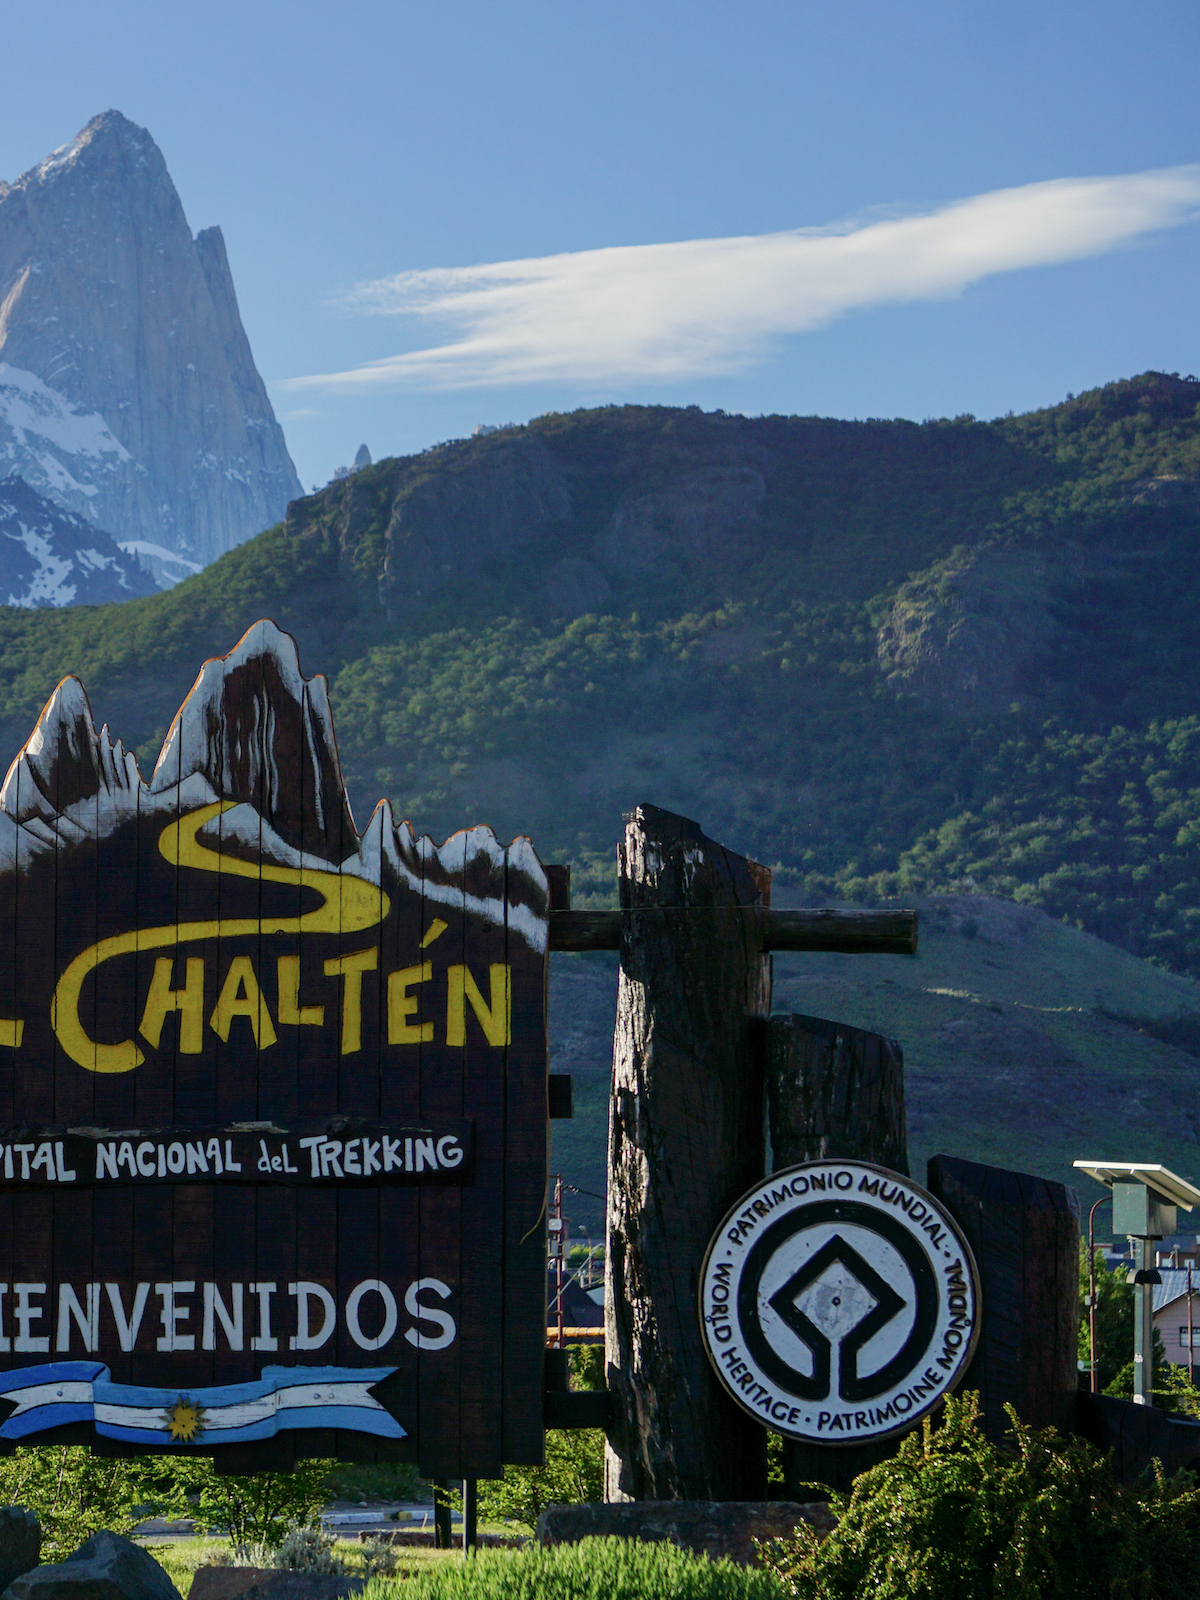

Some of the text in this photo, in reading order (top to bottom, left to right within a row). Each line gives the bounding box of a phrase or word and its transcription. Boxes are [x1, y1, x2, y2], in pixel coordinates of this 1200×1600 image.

[50, 918, 512, 1074] CHALTÉN
[95, 1137, 241, 1180] NACIONAL
[300, 1135, 463, 1179] TREKKING
[727, 1171, 950, 1250] PATRIMONIO MUNDIAL
[711, 1262, 801, 1425] WORLD HERITAGE
[817, 1258, 970, 1431] PATRIMOINE MONDIAL
